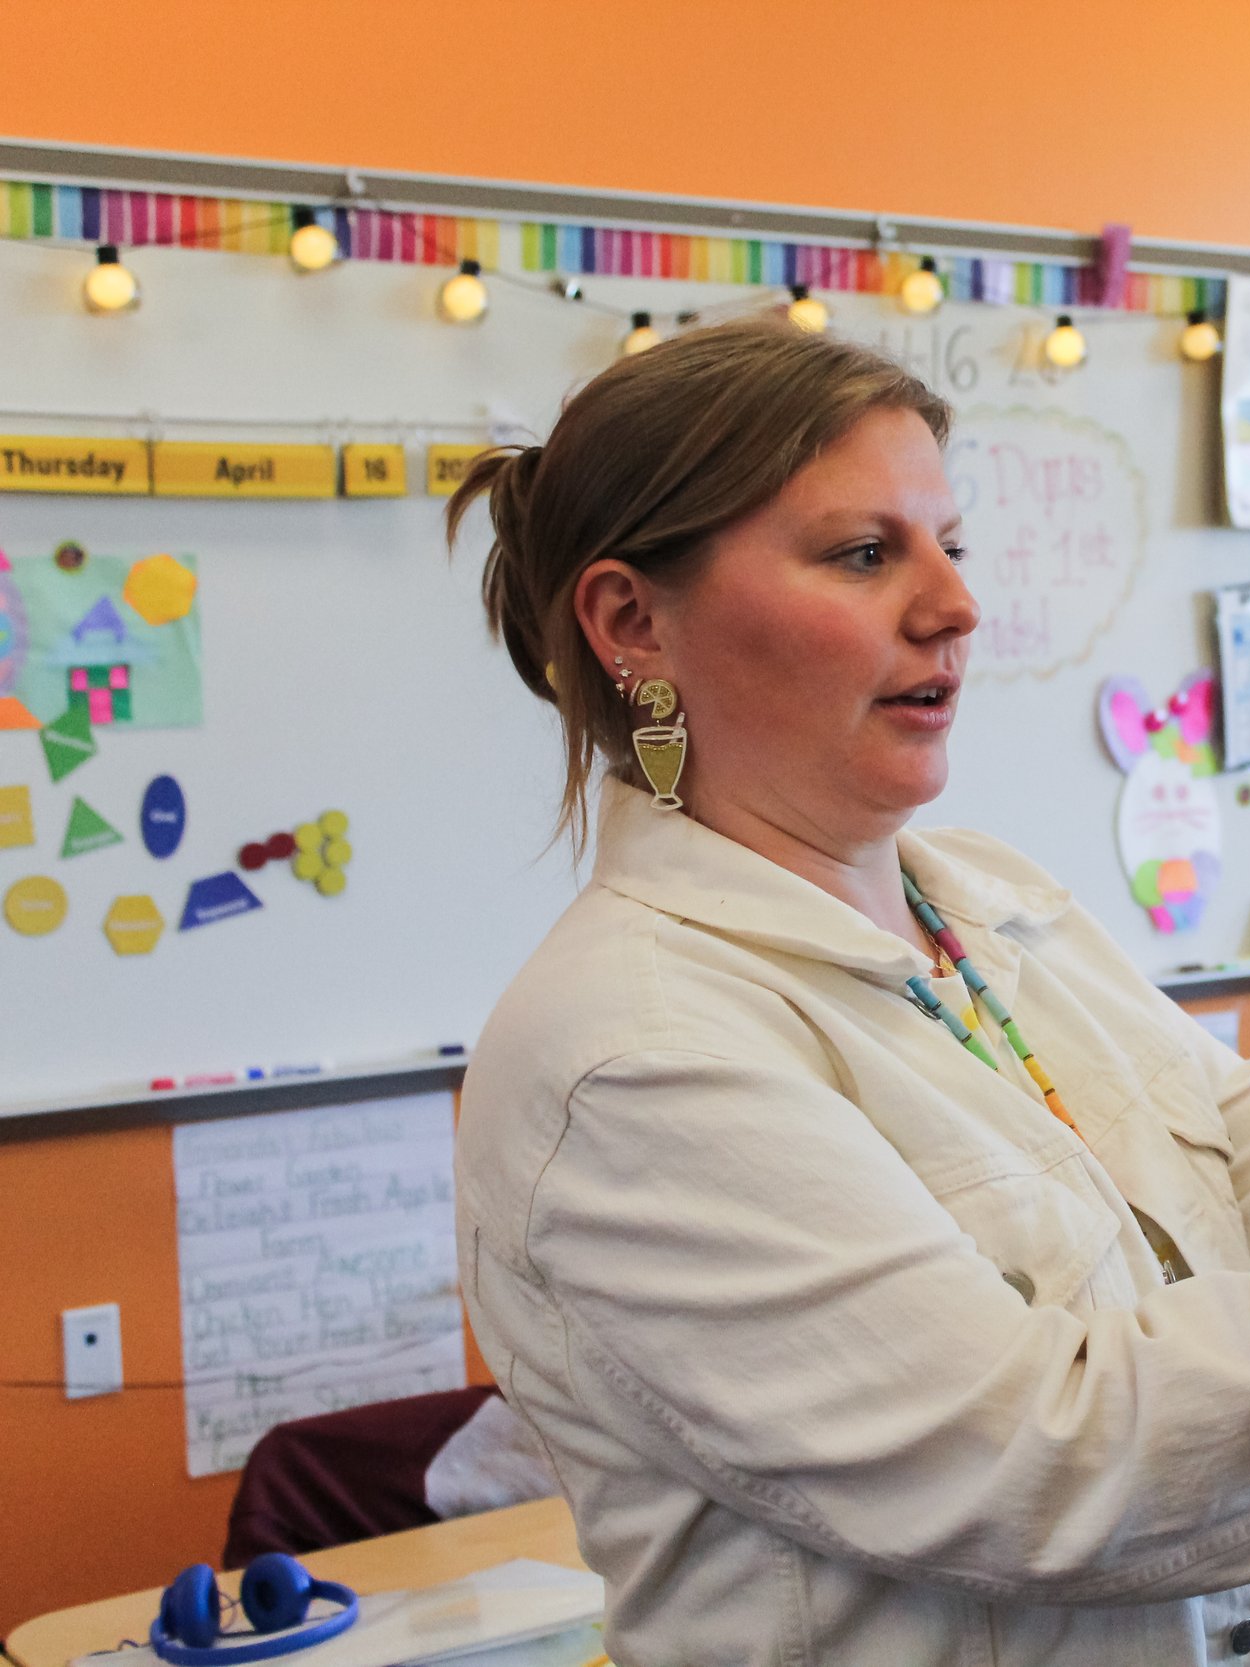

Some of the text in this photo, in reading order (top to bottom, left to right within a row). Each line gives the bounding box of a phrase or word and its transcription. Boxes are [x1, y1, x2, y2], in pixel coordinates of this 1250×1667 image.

[3, 449, 125, 485] Thursday
[215, 456, 276, 487] April
[365, 456, 389, 482] 16
[994, 523, 1036, 588] of
